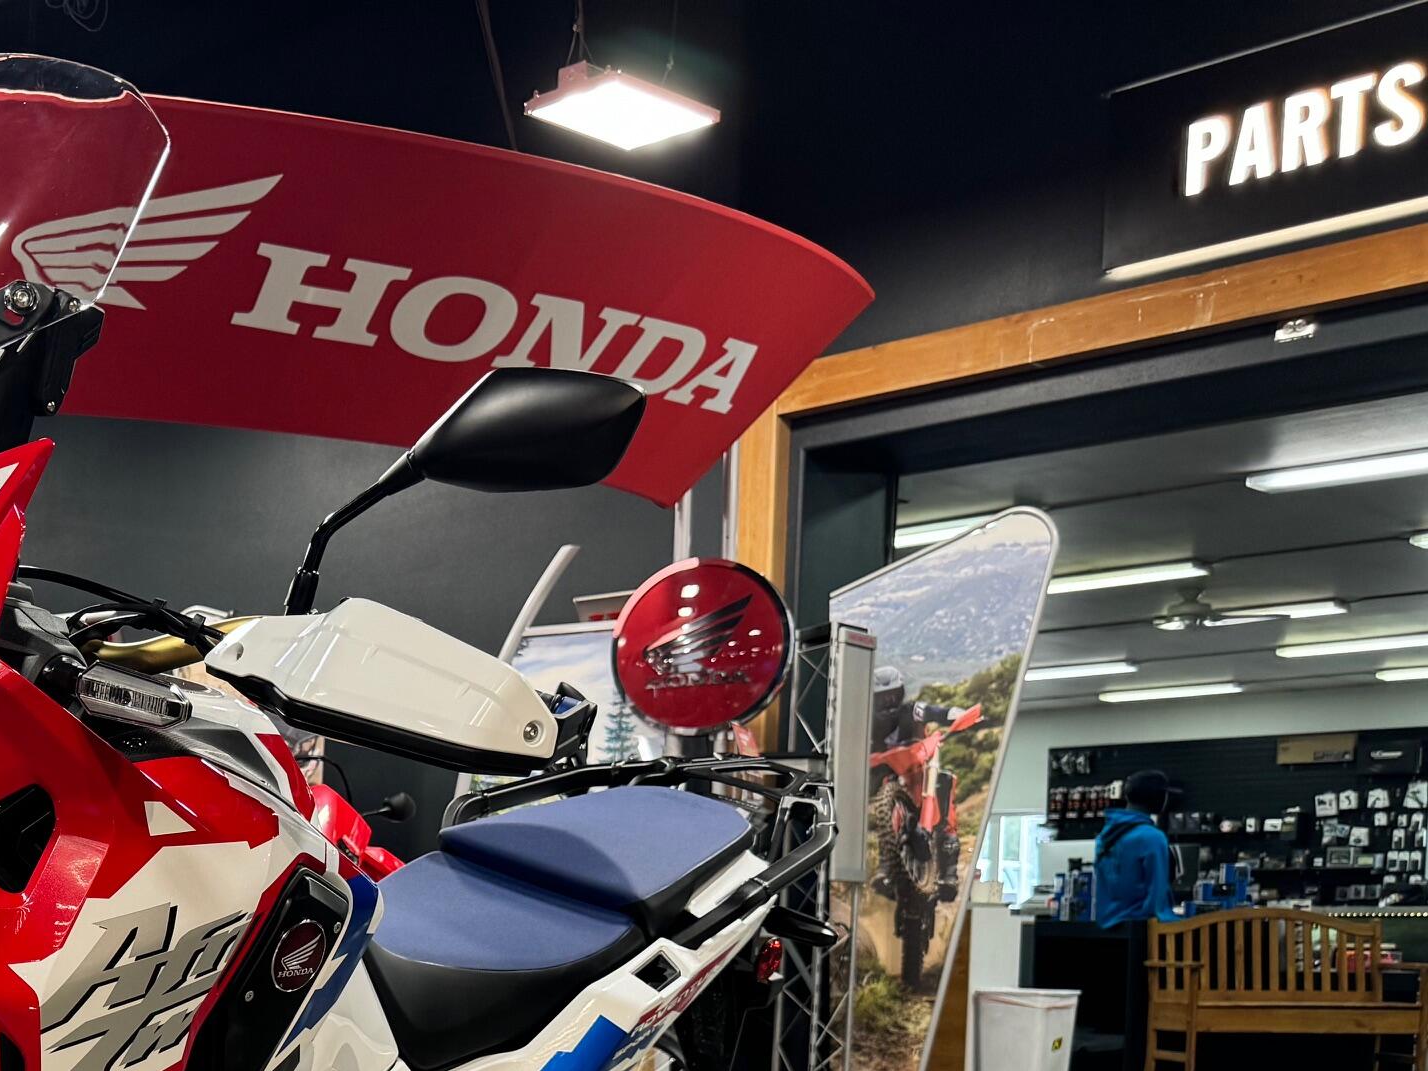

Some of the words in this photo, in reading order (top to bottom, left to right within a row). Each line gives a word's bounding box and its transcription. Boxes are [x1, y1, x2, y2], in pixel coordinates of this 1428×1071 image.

[1184, 61, 1426, 197] PARTS
[231, 242, 759, 414] HONDA
[277, 967, 314, 978] HONDA
